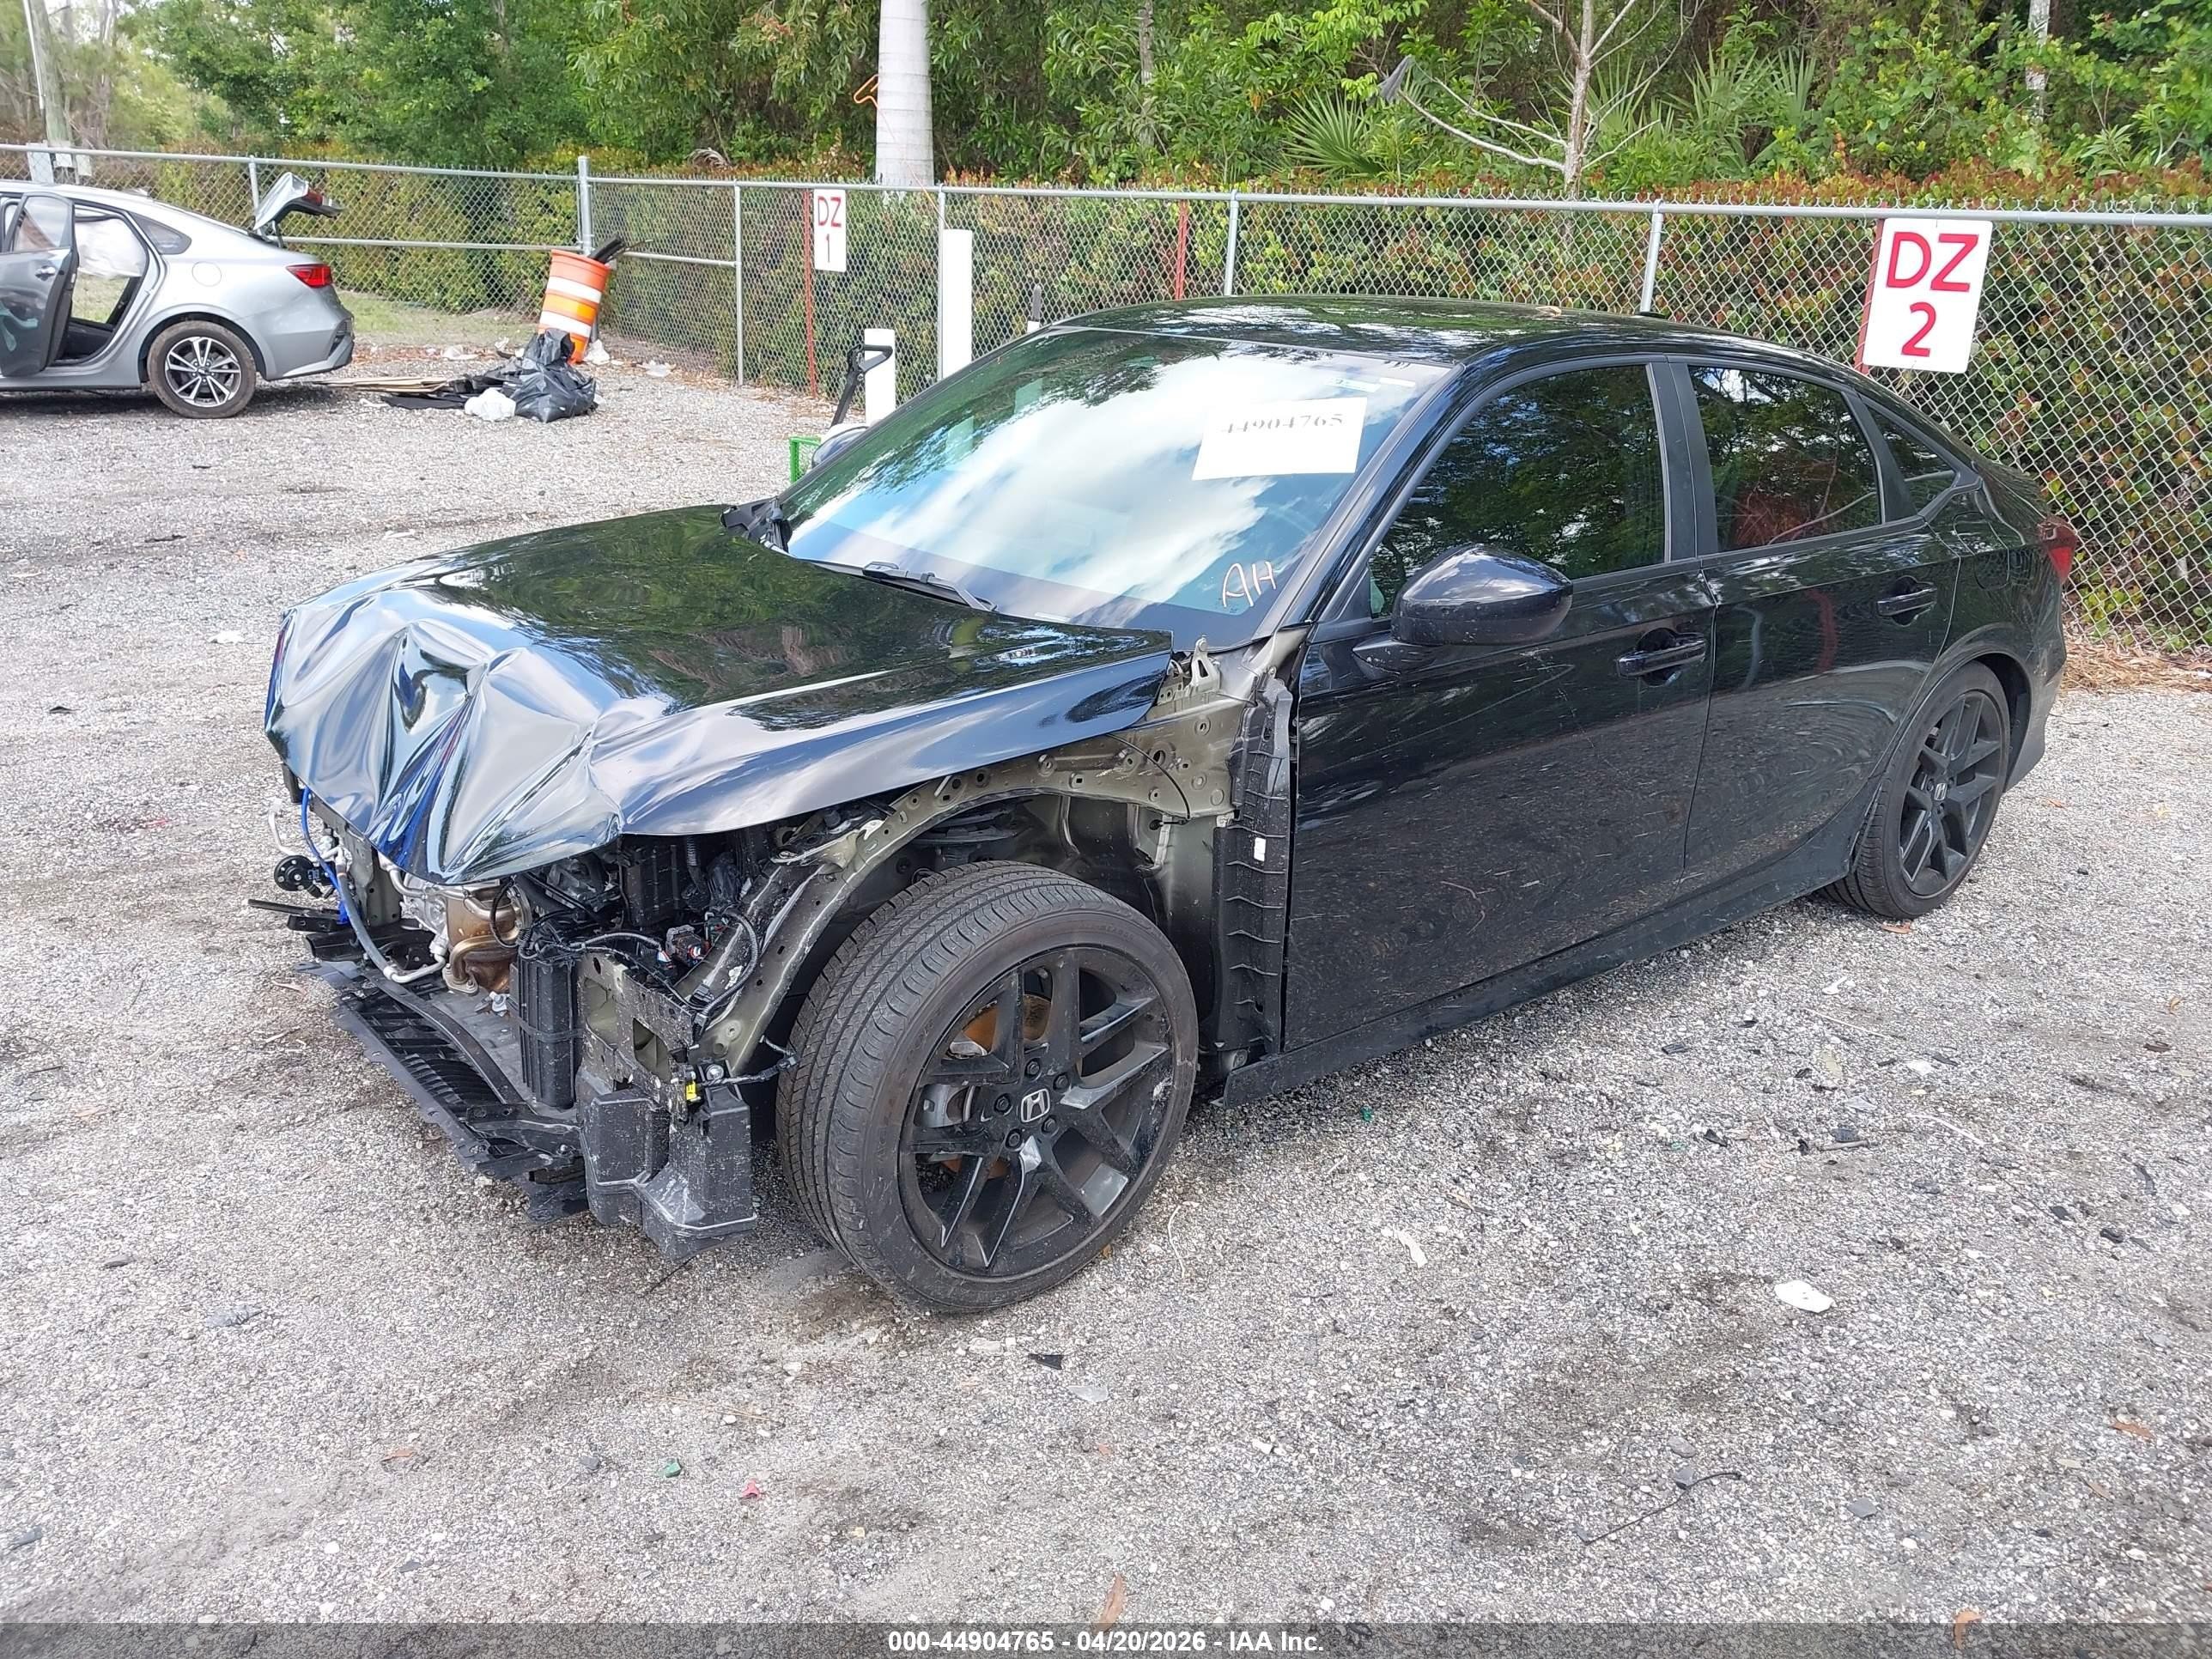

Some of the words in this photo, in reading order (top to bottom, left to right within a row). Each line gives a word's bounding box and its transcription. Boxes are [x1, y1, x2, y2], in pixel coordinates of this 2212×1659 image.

[817, 196, 842, 228] DZ
[825, 234, 831, 263] 1
[1885, 231, 1979, 293] DZ
[1900, 301, 1936, 357] 2
[1222, 561, 1277, 608] AH
